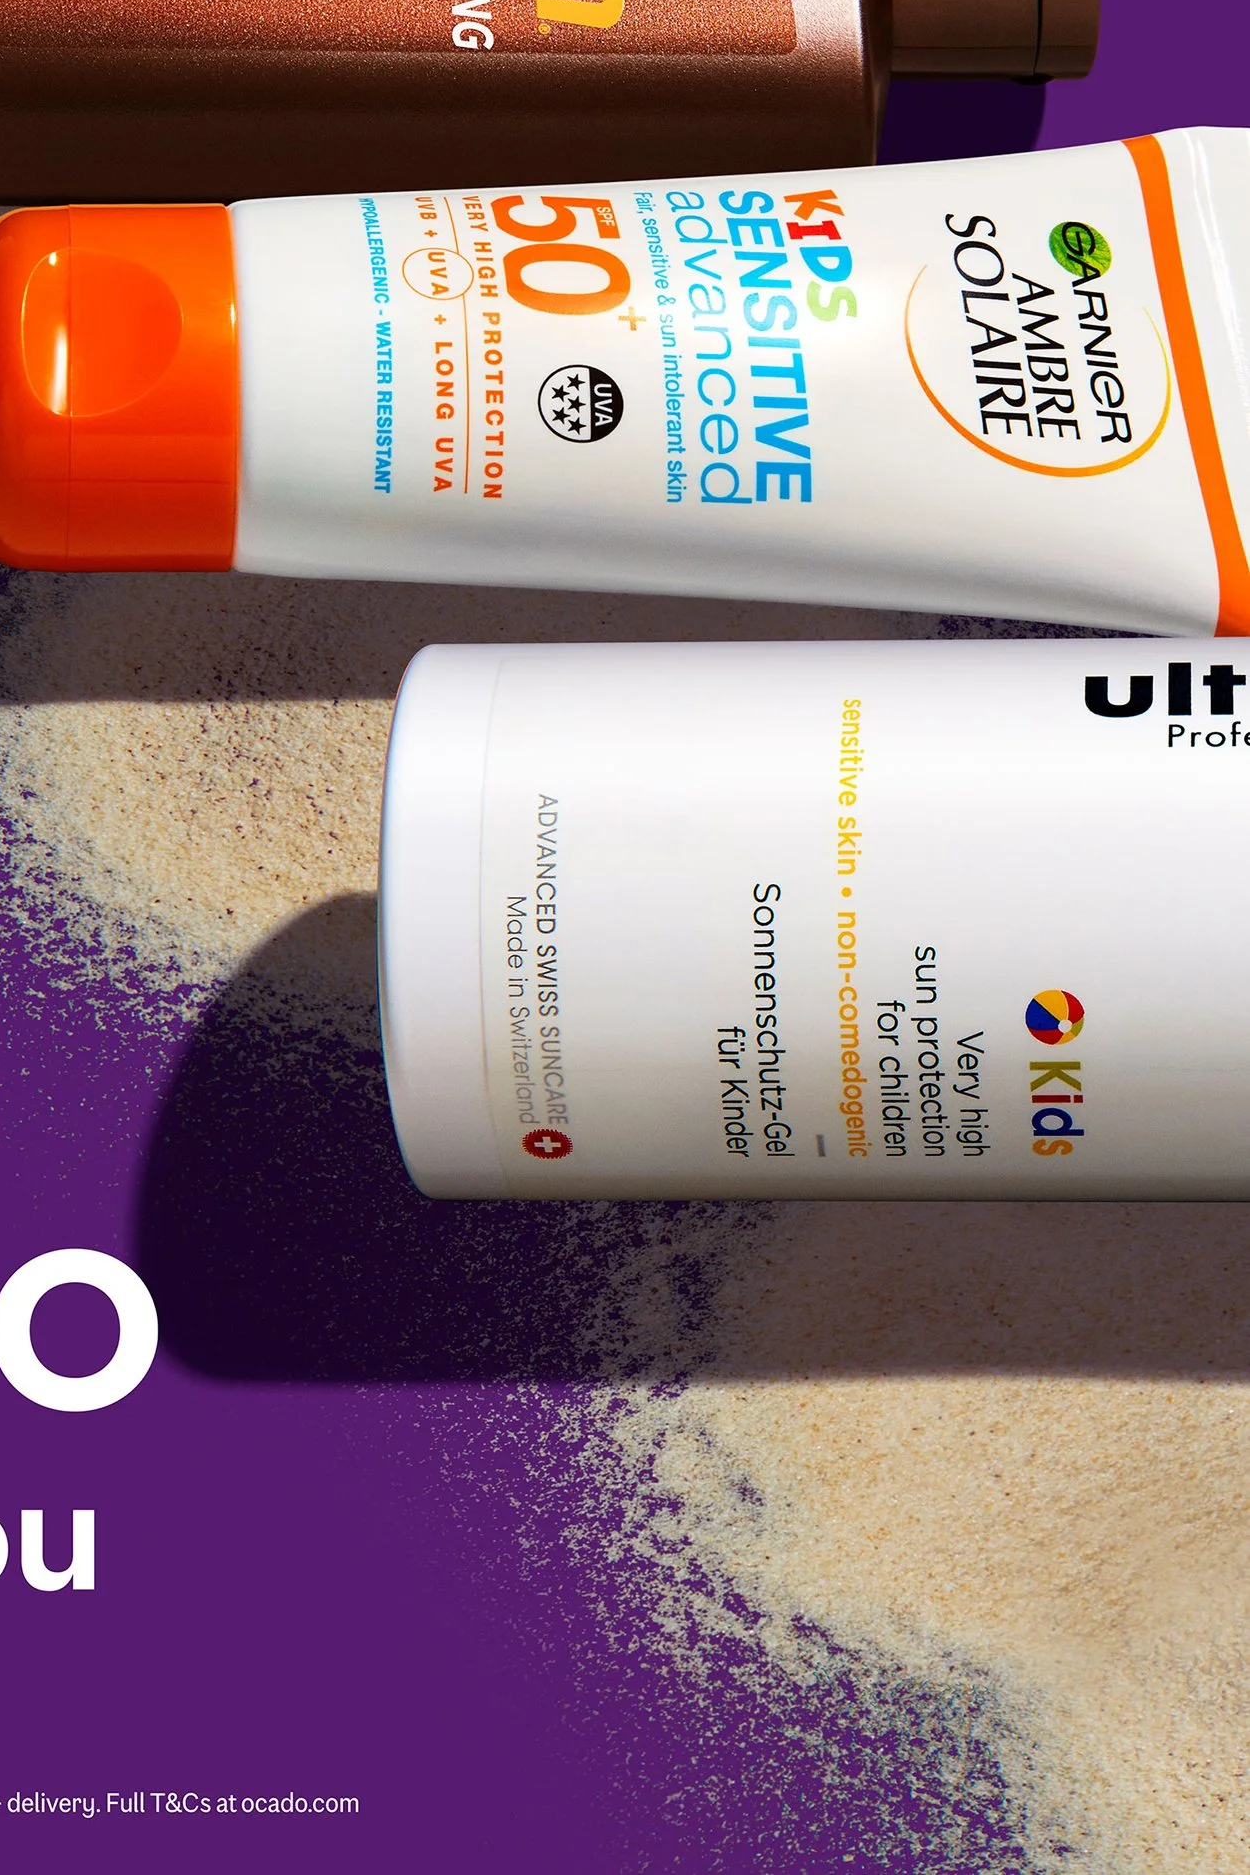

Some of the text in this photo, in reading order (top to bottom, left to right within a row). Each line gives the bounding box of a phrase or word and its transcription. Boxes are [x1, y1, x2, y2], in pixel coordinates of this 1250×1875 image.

[359, 197, 390, 304] HYPOALLERGENIC
[491, 195, 647, 331] 50+
[596, 206, 615, 227] SPF
[783, 189, 858, 323] KIDS
[376, 322, 393, 384] WATER
[462, 195, 504, 499] VERY HIGH PROTECTION
[593, 383, 613, 427] UVA
[633, 191, 687, 503] Fair, sensitive & sun intolerant skin
[665, 190, 752, 504] advanced
[718, 190, 812, 503] SENSITIVE
[946, 214, 1032, 437] SOLAIRE
[1012, 271, 1081, 441] AMBRE
[374, 391, 393, 493] RESISTANT
[1085, 662, 1246, 718] ult
[535, 793, 569, 1126] ADVANCED SWISS SUNCARE
[835, 698, 874, 1159] sensitive skin non-comedogenic
[506, 895, 539, 1125] Made in Switzerland
[752, 881, 795, 1159] Sonnenschutz-Gel
[877, 998, 911, 1158] for children
[911, 945, 950, 1158] sun protection
[716, 1025, 754, 1158] für Kinder
[953, 1031, 991, 1159] Very high
[1028, 1059, 1085, 1158] Kids
